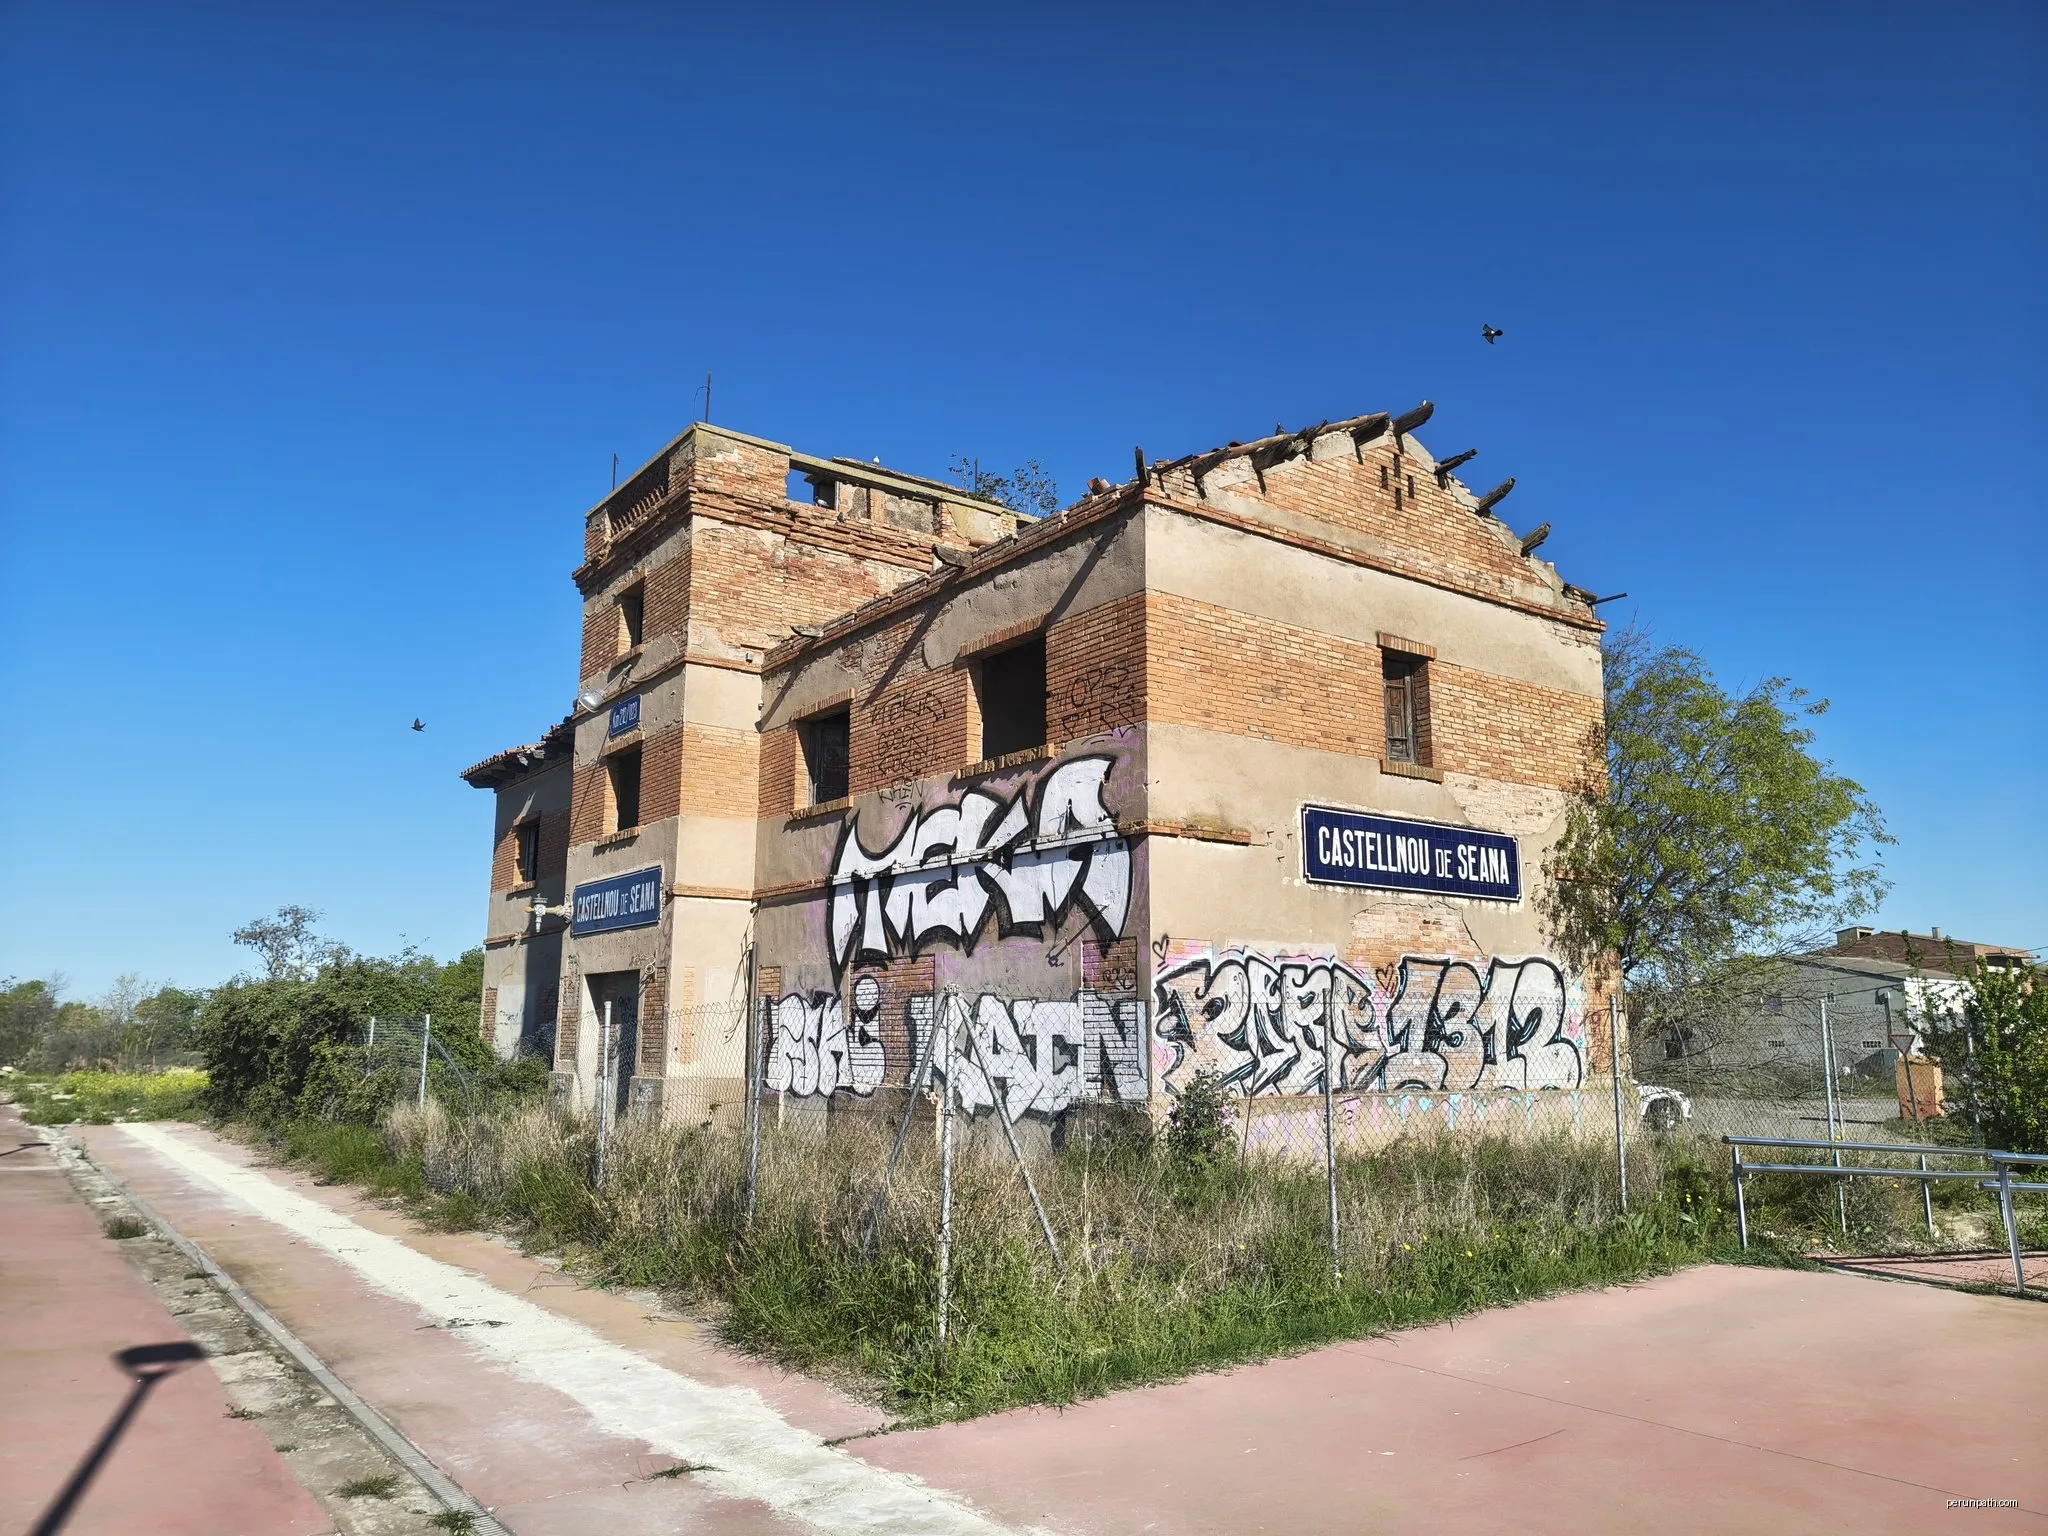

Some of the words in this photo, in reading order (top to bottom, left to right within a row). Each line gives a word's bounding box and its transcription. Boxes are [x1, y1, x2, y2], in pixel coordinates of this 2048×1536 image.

[1318, 826, 1430, 875] CASTELLNOU
[1435, 848, 1453, 878] DE
[1457, 844, 1510, 885] SEANA
[576, 889, 620, 923] CASTELLNOU
[620, 893, 629, 916] DE
[629, 881, 655, 914] SEANA
